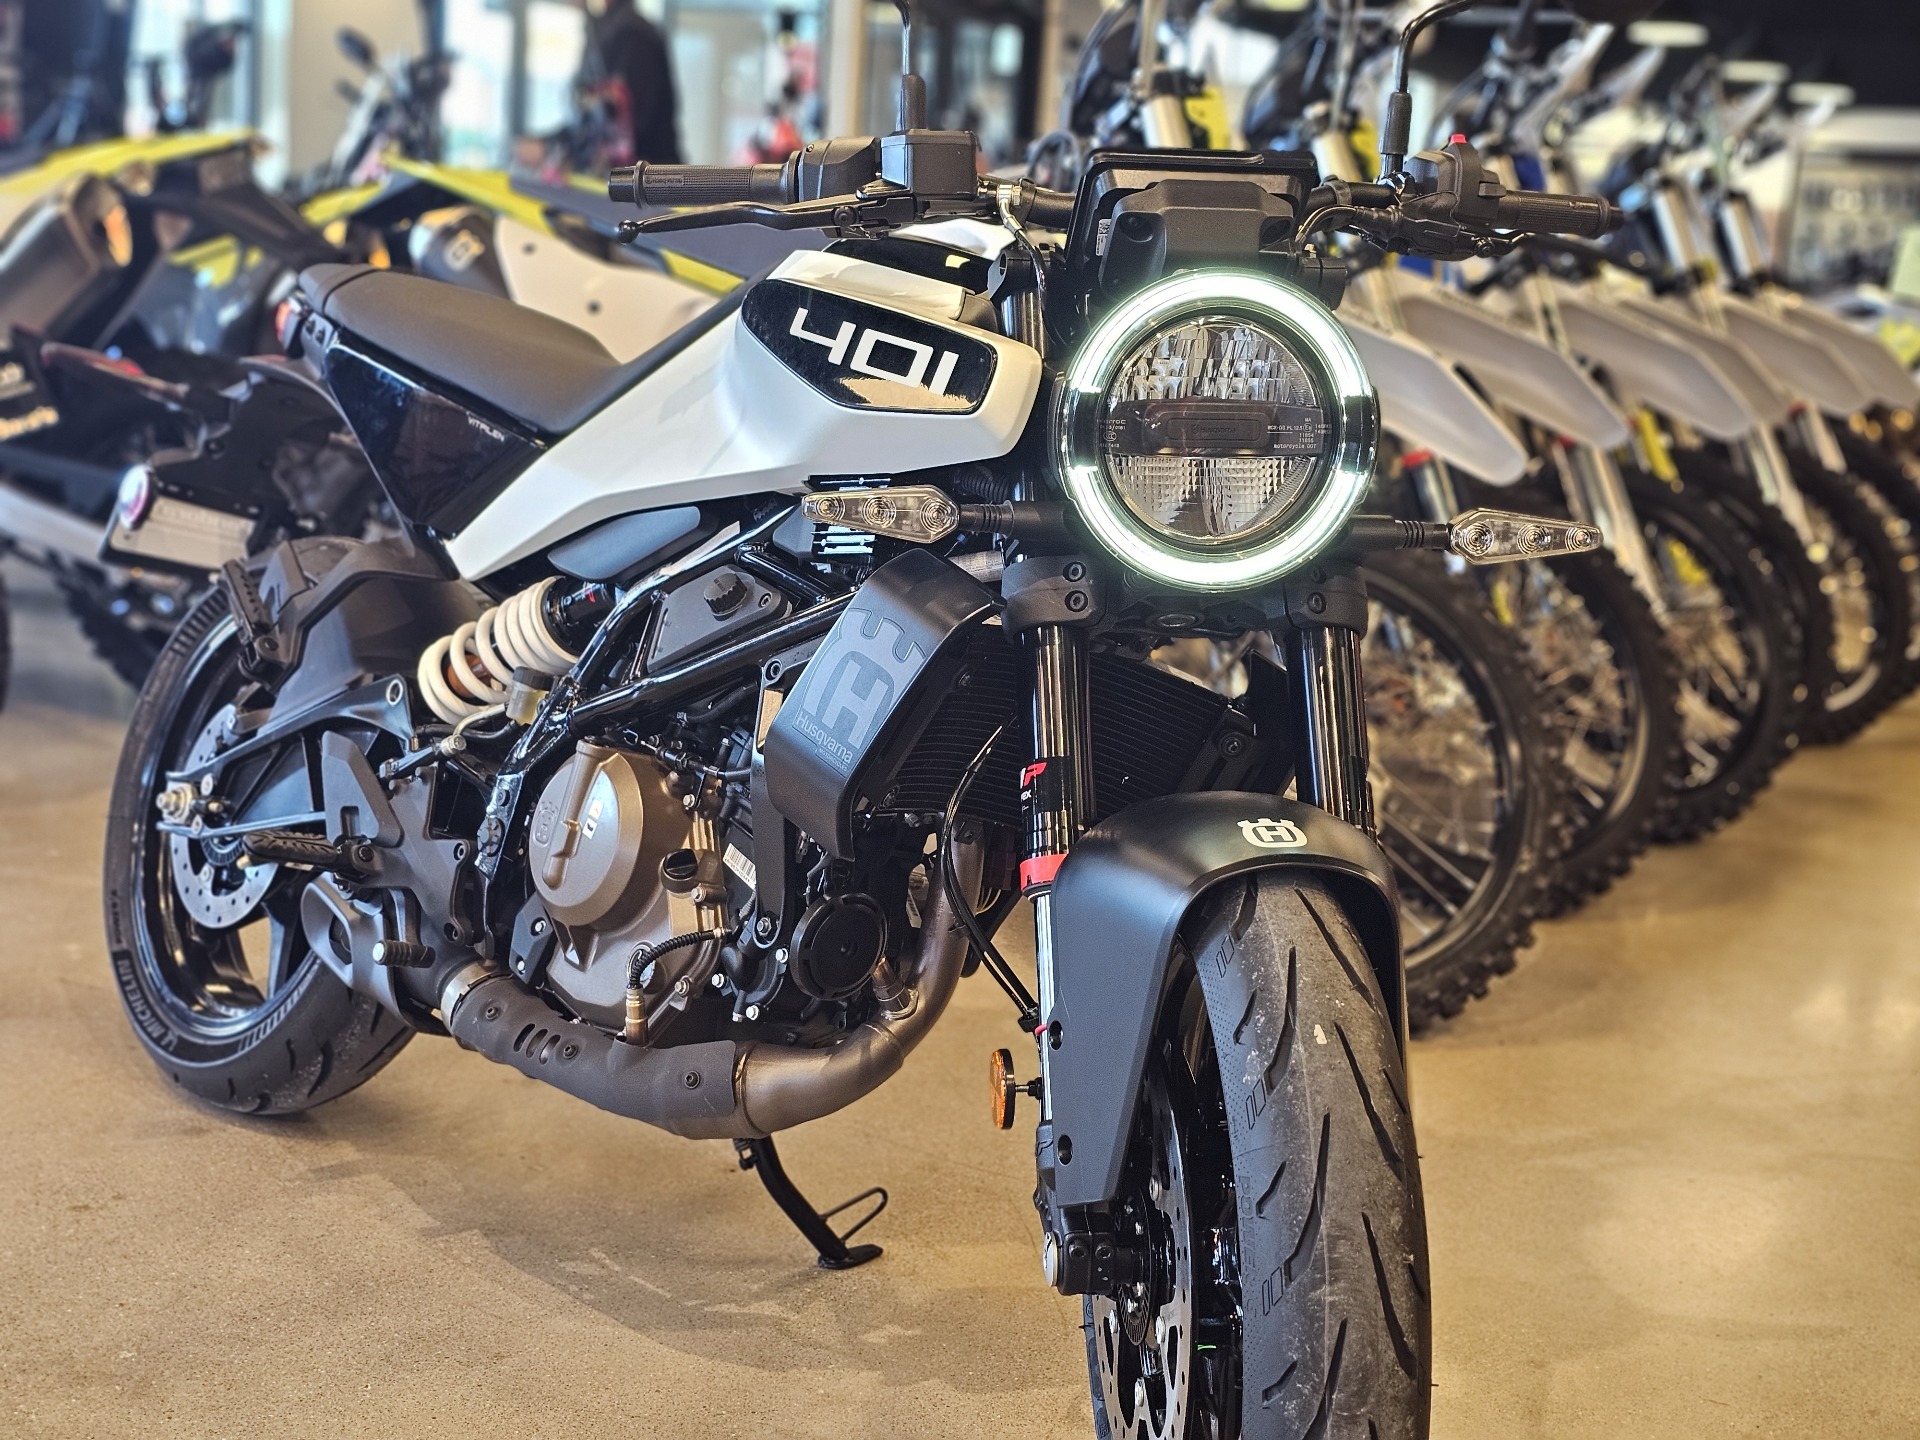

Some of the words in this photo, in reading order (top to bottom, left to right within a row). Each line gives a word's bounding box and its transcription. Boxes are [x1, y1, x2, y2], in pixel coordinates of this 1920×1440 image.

[789, 307, 960, 396] 401
[796, 711, 853, 764] Husqvarna
[117, 959, 162, 1039] MICHELIN
